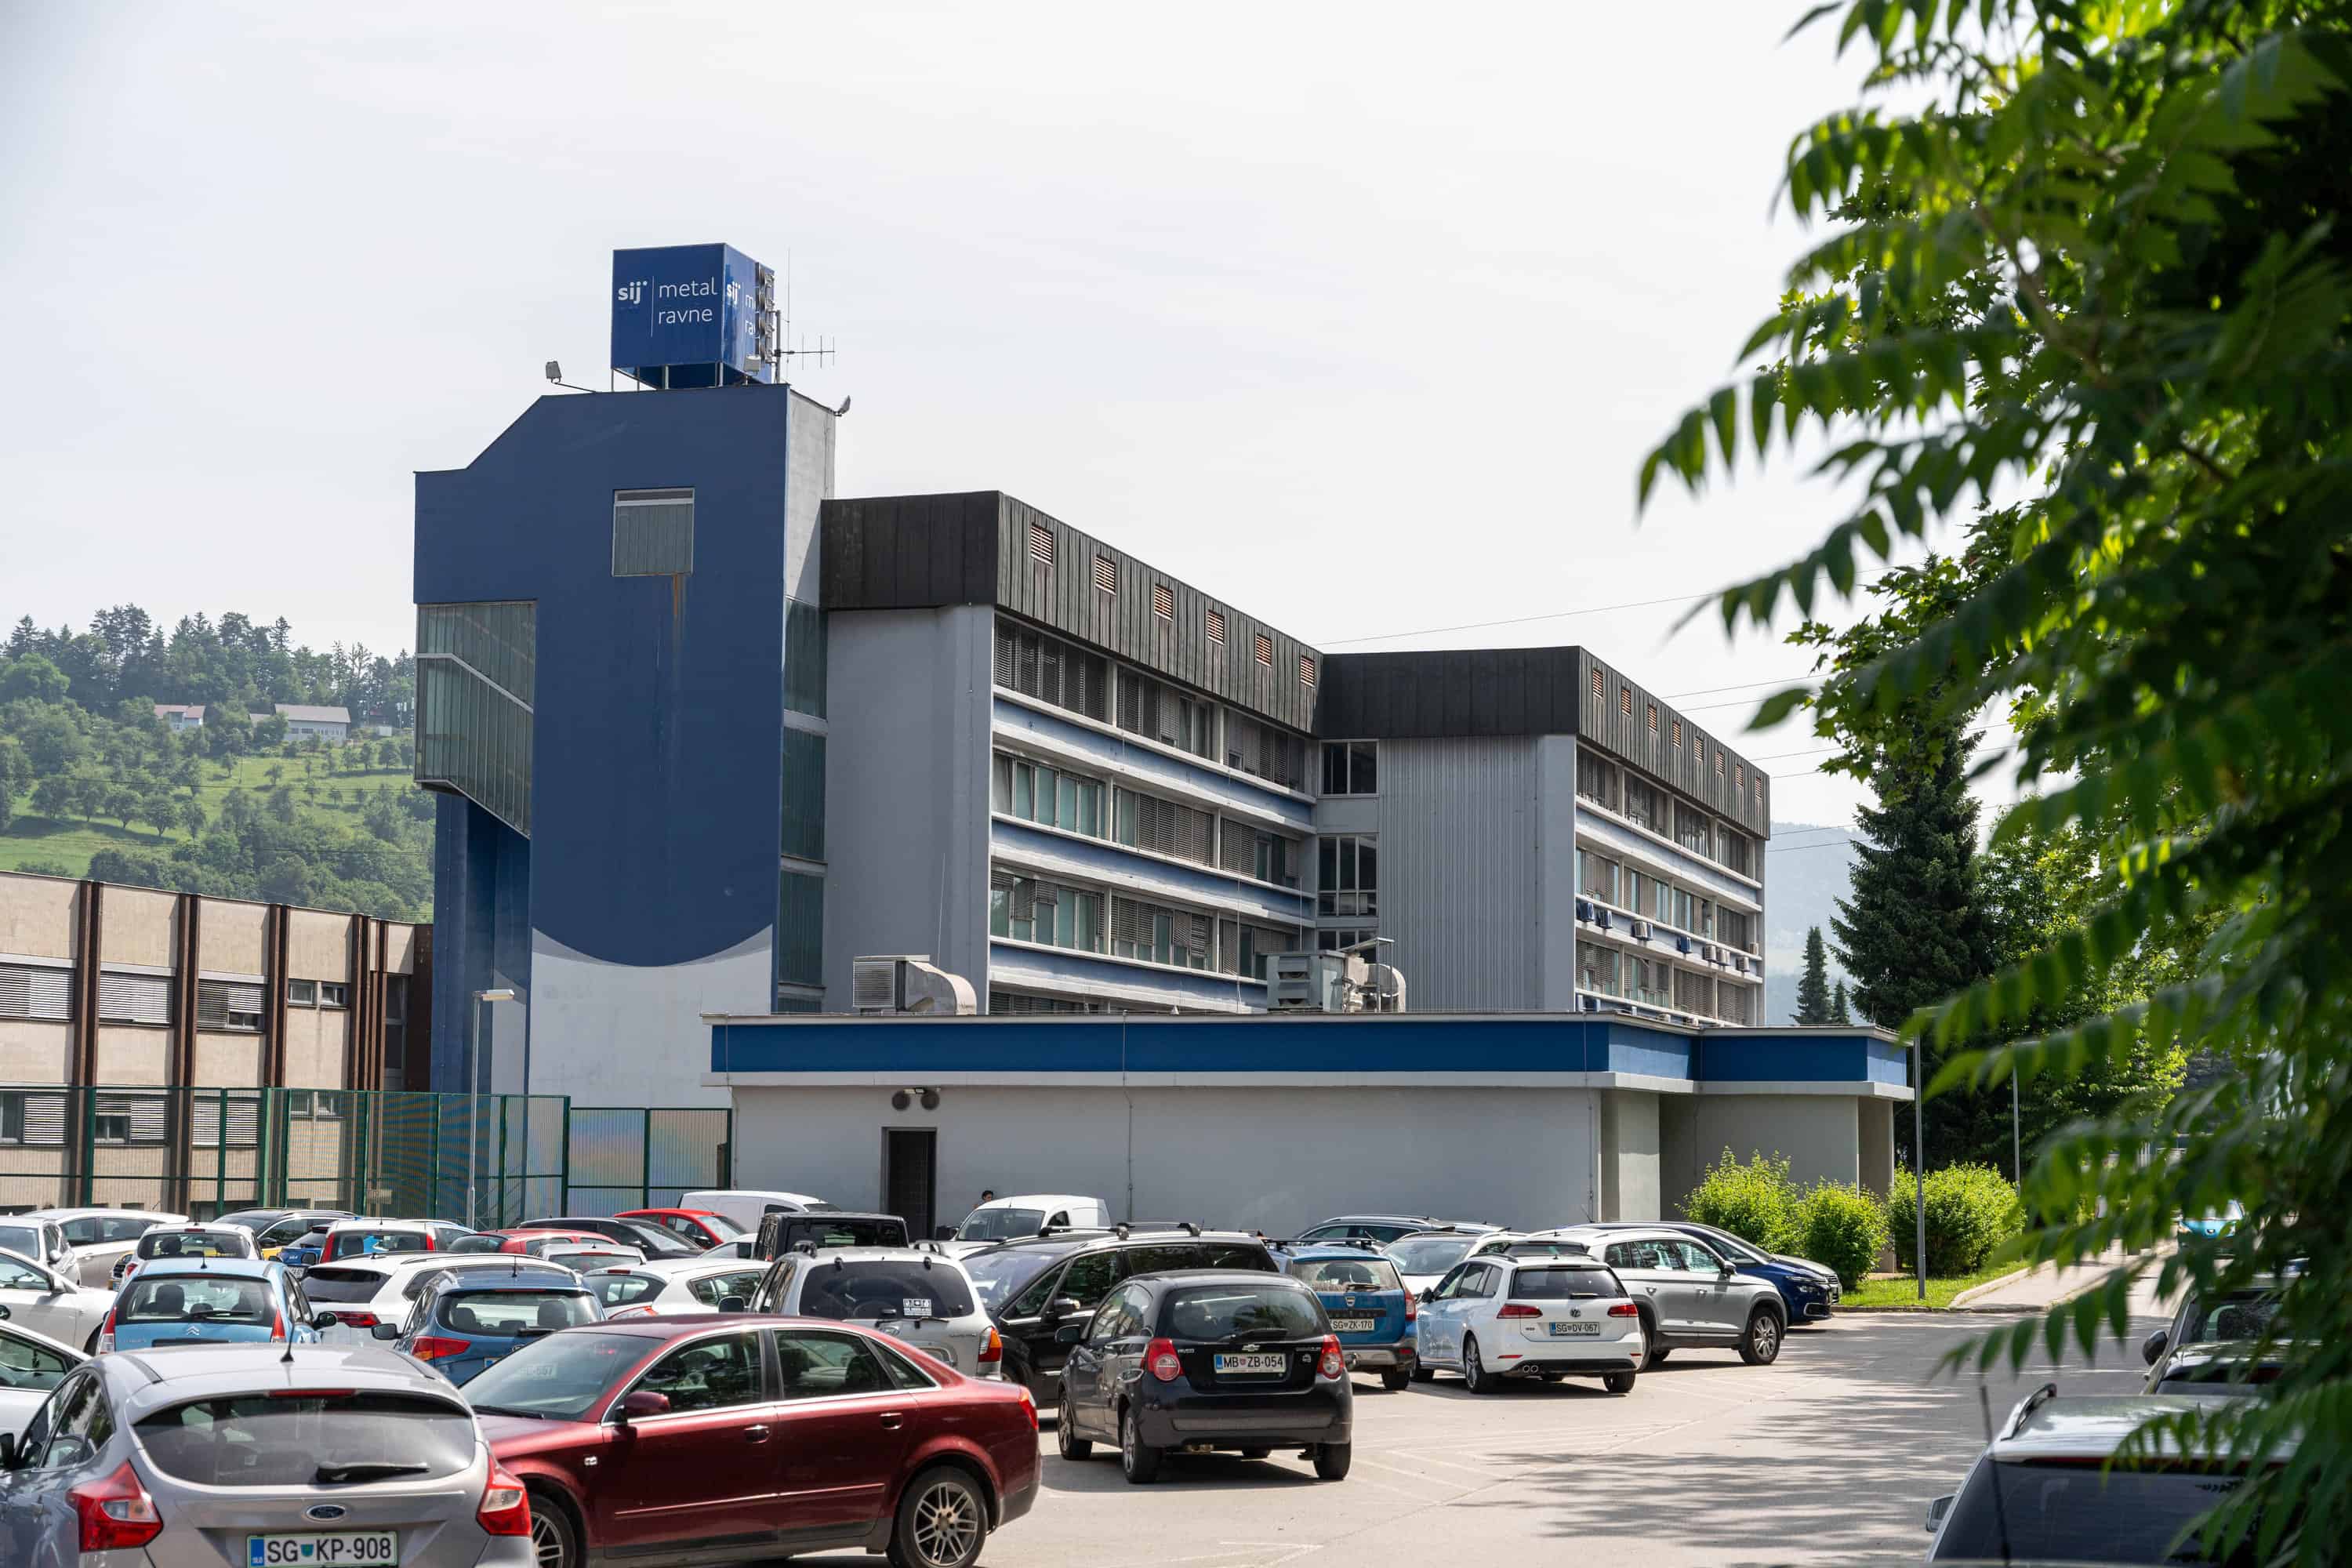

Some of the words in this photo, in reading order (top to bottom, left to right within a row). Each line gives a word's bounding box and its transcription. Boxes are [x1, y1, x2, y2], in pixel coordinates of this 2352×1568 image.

[618, 281, 641, 304] sij
[659, 276, 718, 298] metal
[727, 281, 739, 305] sij
[659, 308, 713, 325] ravne
[1556, 1323, 1567, 1332] SG
[1224, 1358, 1239, 1367] MB
[1247, 1358, 1283, 1367] ZB-054
[267, 1540, 298, 1563] SG
[316, 1537, 391, 1561] KP-908
